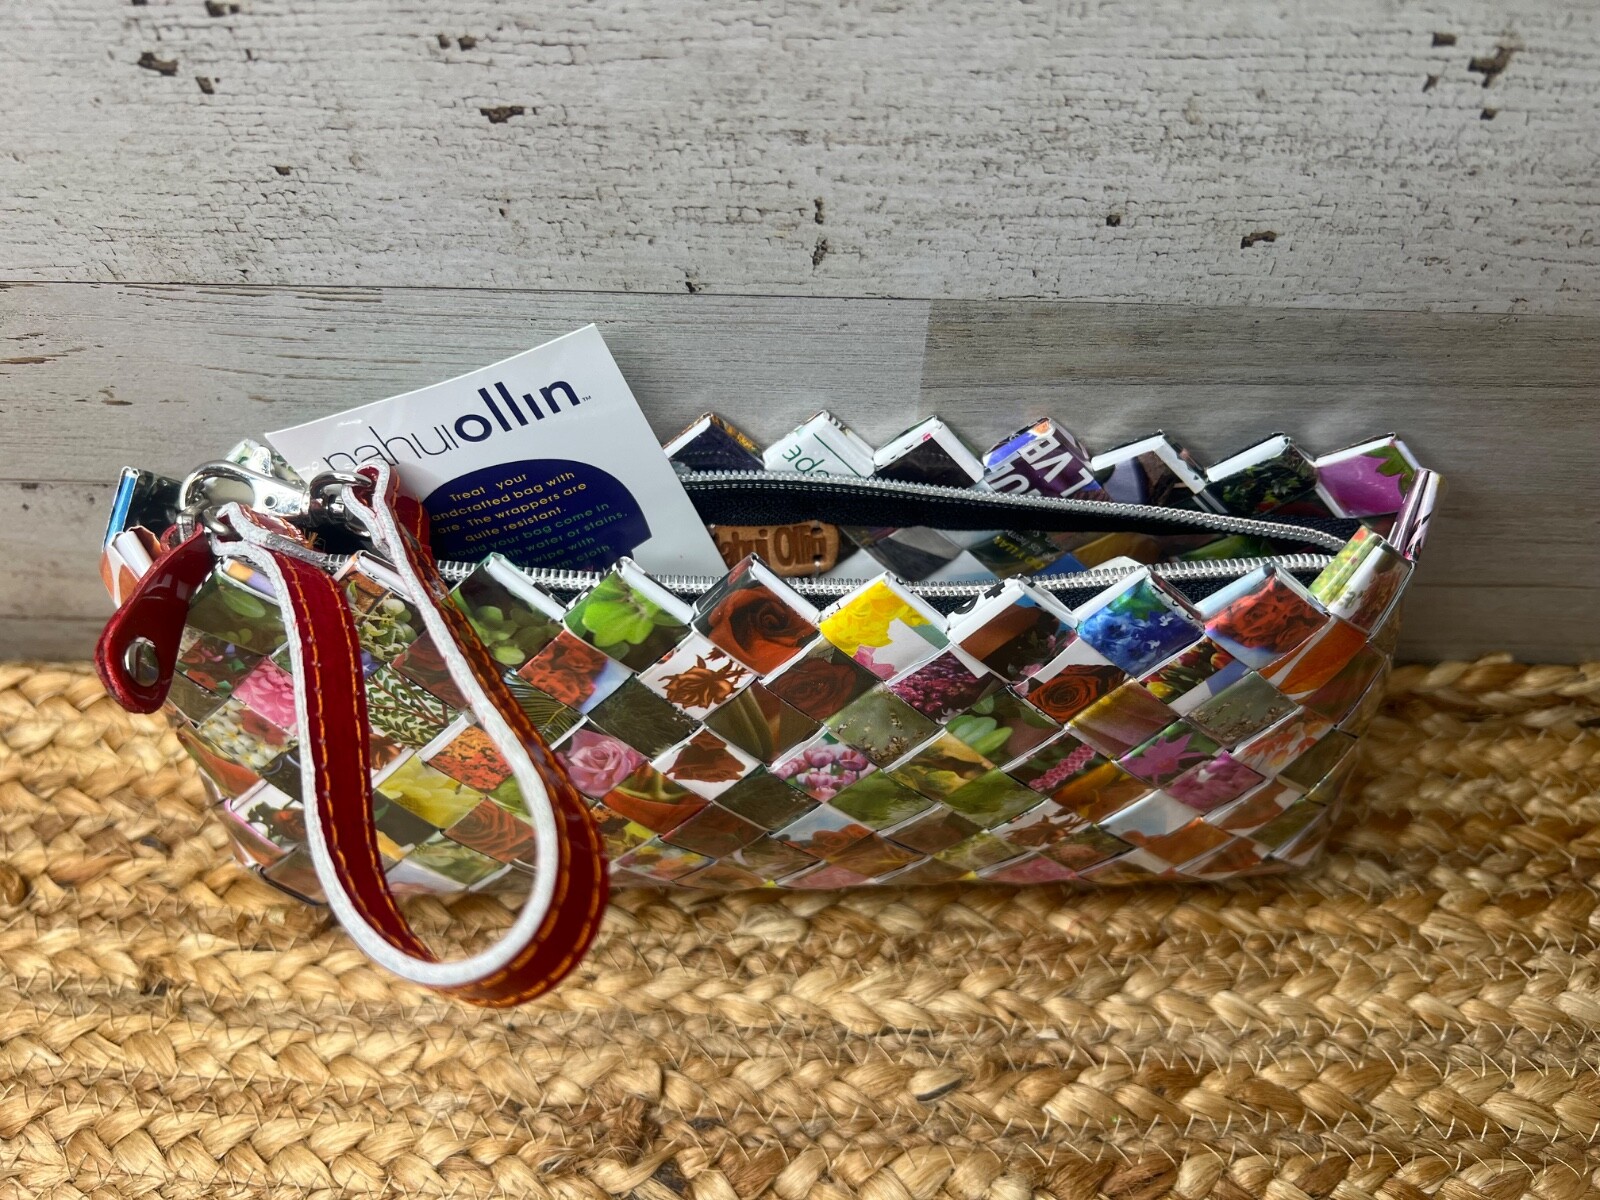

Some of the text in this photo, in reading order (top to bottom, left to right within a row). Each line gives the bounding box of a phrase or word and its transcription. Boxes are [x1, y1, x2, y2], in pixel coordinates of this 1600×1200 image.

[432, 472, 575, 521] andcrafted bag with
[437, 483, 587, 534] are. The wrappers are
[449, 474, 527, 501] Treat your
[448, 502, 610, 559] hould your bag come in
[465, 506, 567, 542] quite resistant.
[505, 511, 628, 558] ith water or stains.
[532, 536, 595, 563] wipe with
